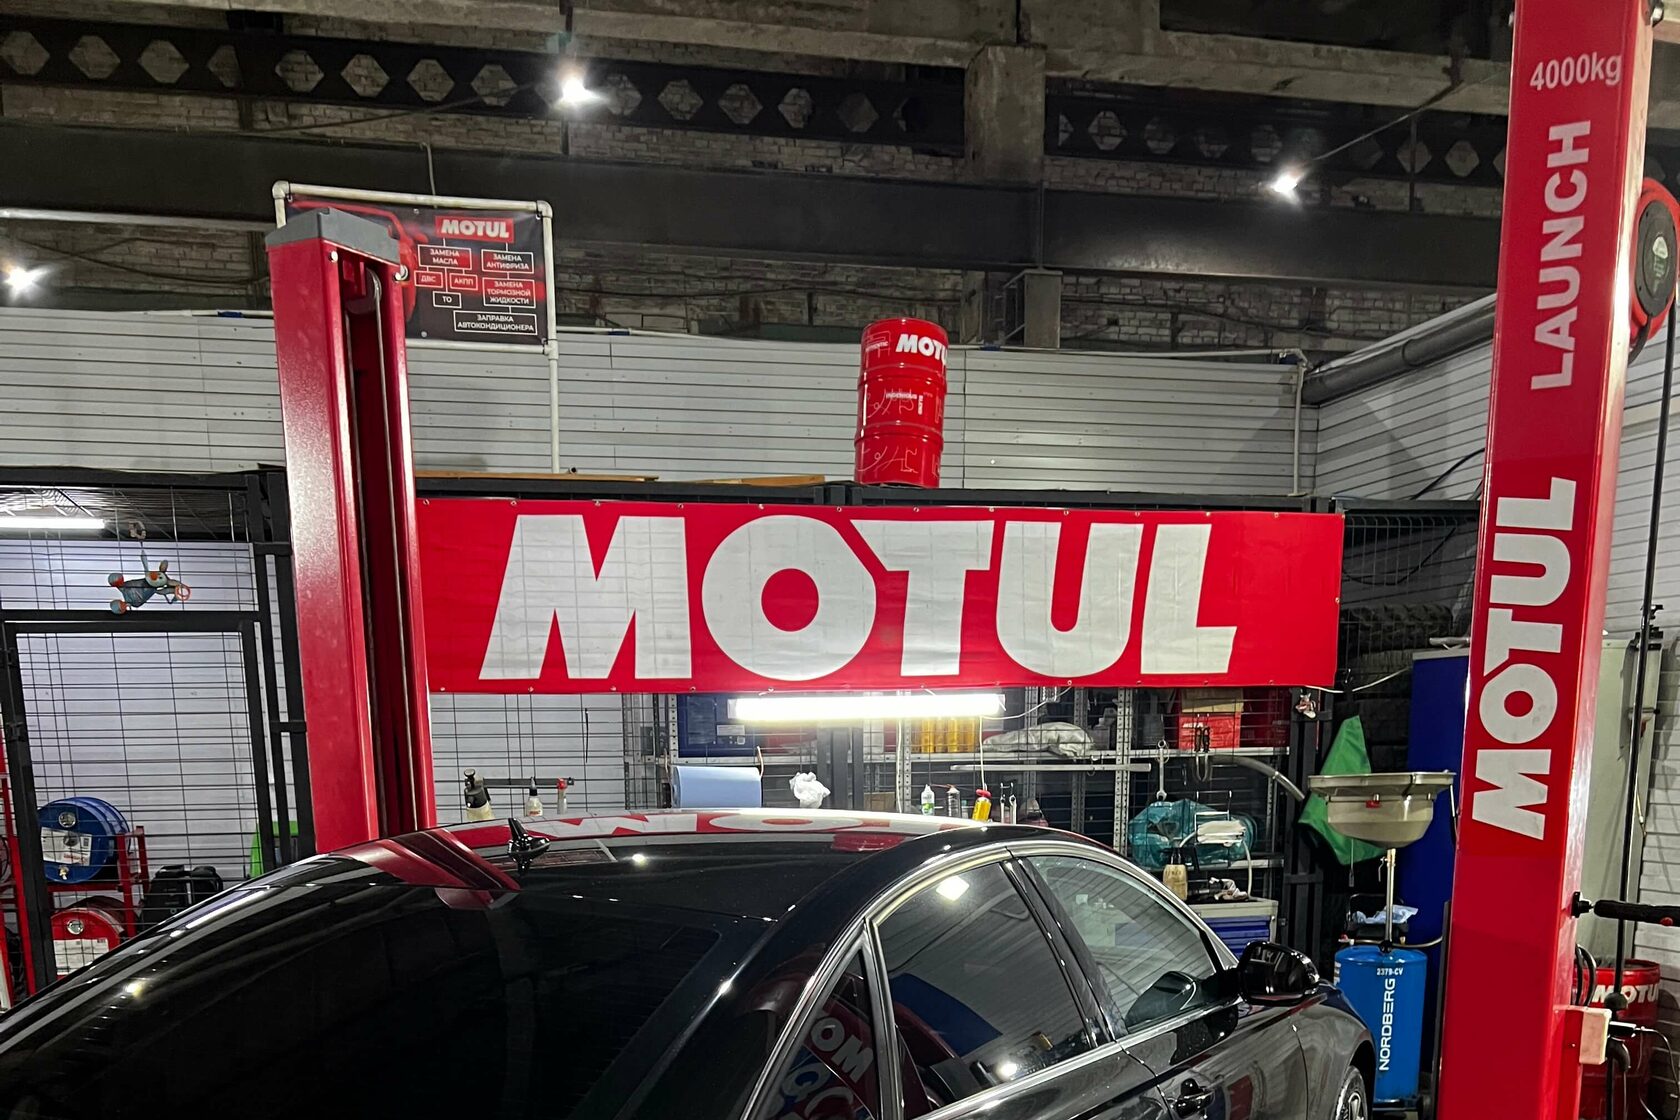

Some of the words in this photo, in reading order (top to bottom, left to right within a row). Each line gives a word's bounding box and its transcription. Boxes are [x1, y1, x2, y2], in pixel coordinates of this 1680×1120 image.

[1529, 52, 1622, 90] 4000kg
[441, 219, 510, 238] MOTUL
[430, 249, 460, 257] ЗАМЕНА
[493, 253, 522, 262] ЗАМЕНА
[1530, 120, 1591, 390] LAUNCH
[486, 261, 530, 270] АНТИФРИЗА
[454, 278, 474, 286] АКПП
[487, 288, 531, 297] ТОРМОЗНОЙ
[490, 296, 530, 305] ЖИДКОСТИ
[477, 314, 514, 322] ЗАПРАВКА
[457, 322, 535, 332] АВТОКОНДИЦИОНЕРА
[479, 513, 1237, 682] MOTUL
[1472, 477, 1577, 841] MOTUL
[1378, 978, 1396, 1071] NORDBERG
